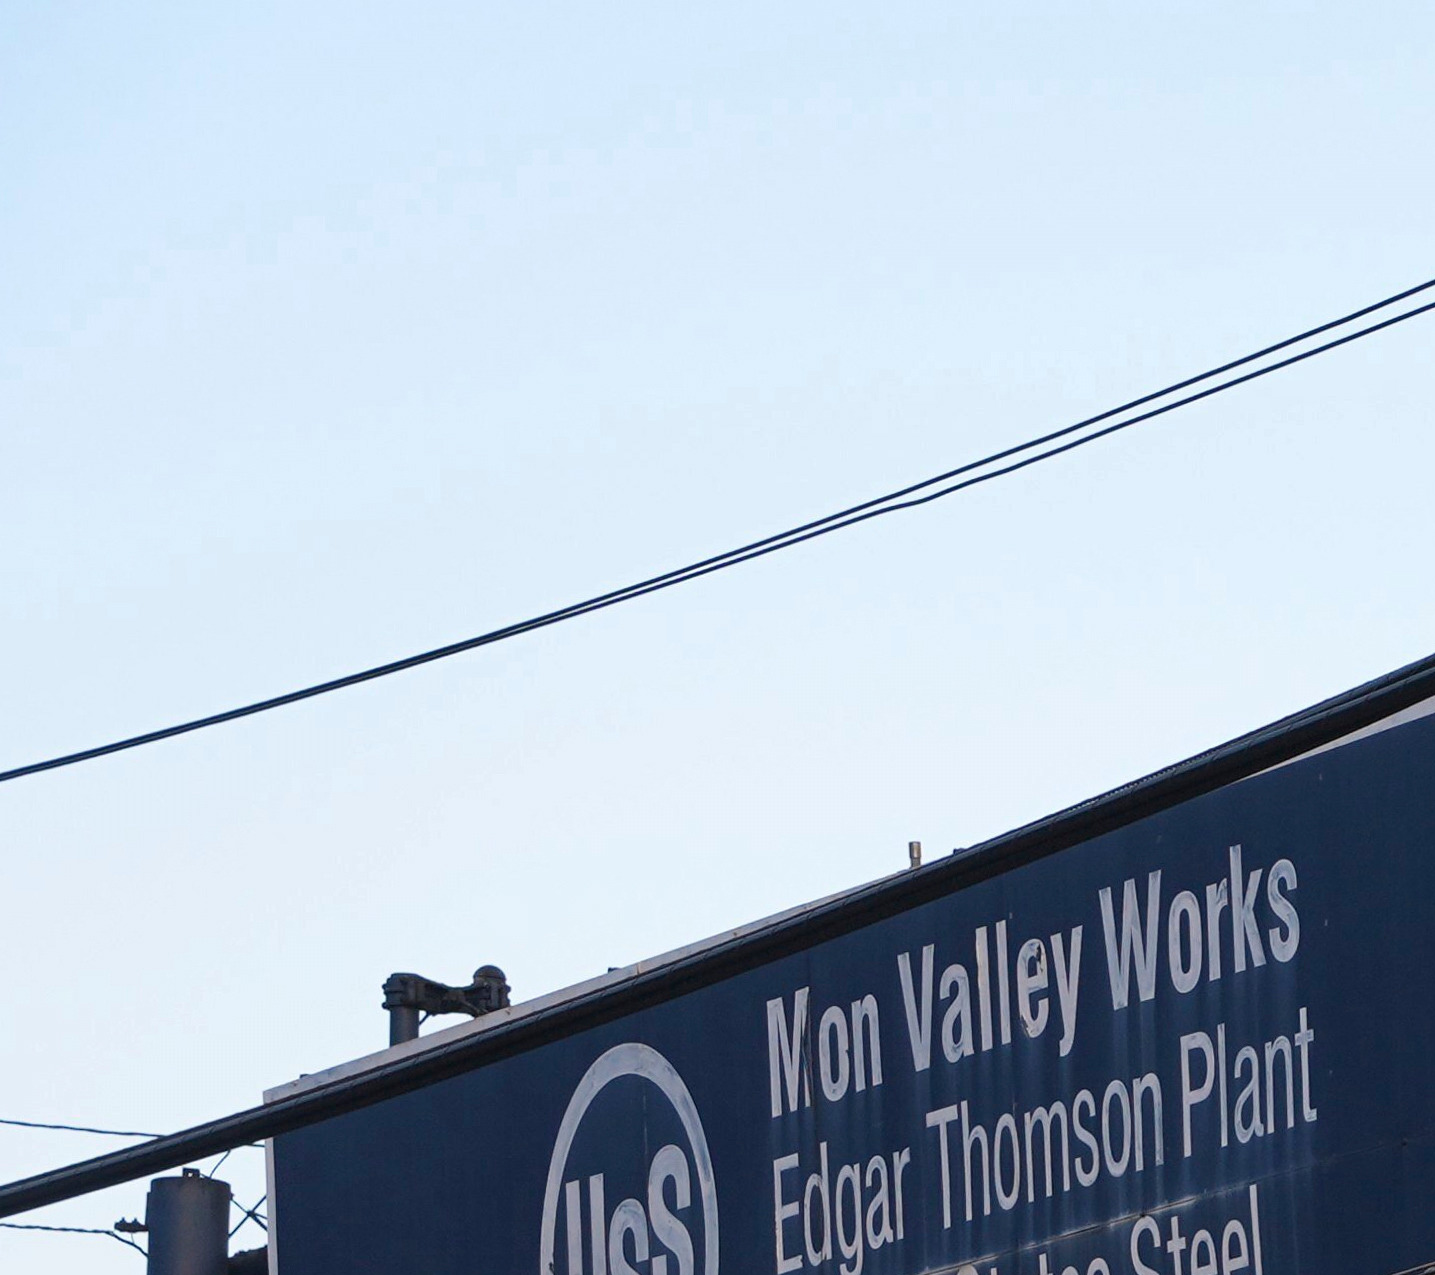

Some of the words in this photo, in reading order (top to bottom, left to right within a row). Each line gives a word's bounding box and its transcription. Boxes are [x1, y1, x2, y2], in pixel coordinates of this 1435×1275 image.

[766, 986, 882, 1117] Mon
[897, 919, 1084, 1072] Valley
[1099, 844, 1300, 1011] Works
[926, 1073, 1166, 1230] Thomson
[1178, 1007, 1318, 1159] Plant
